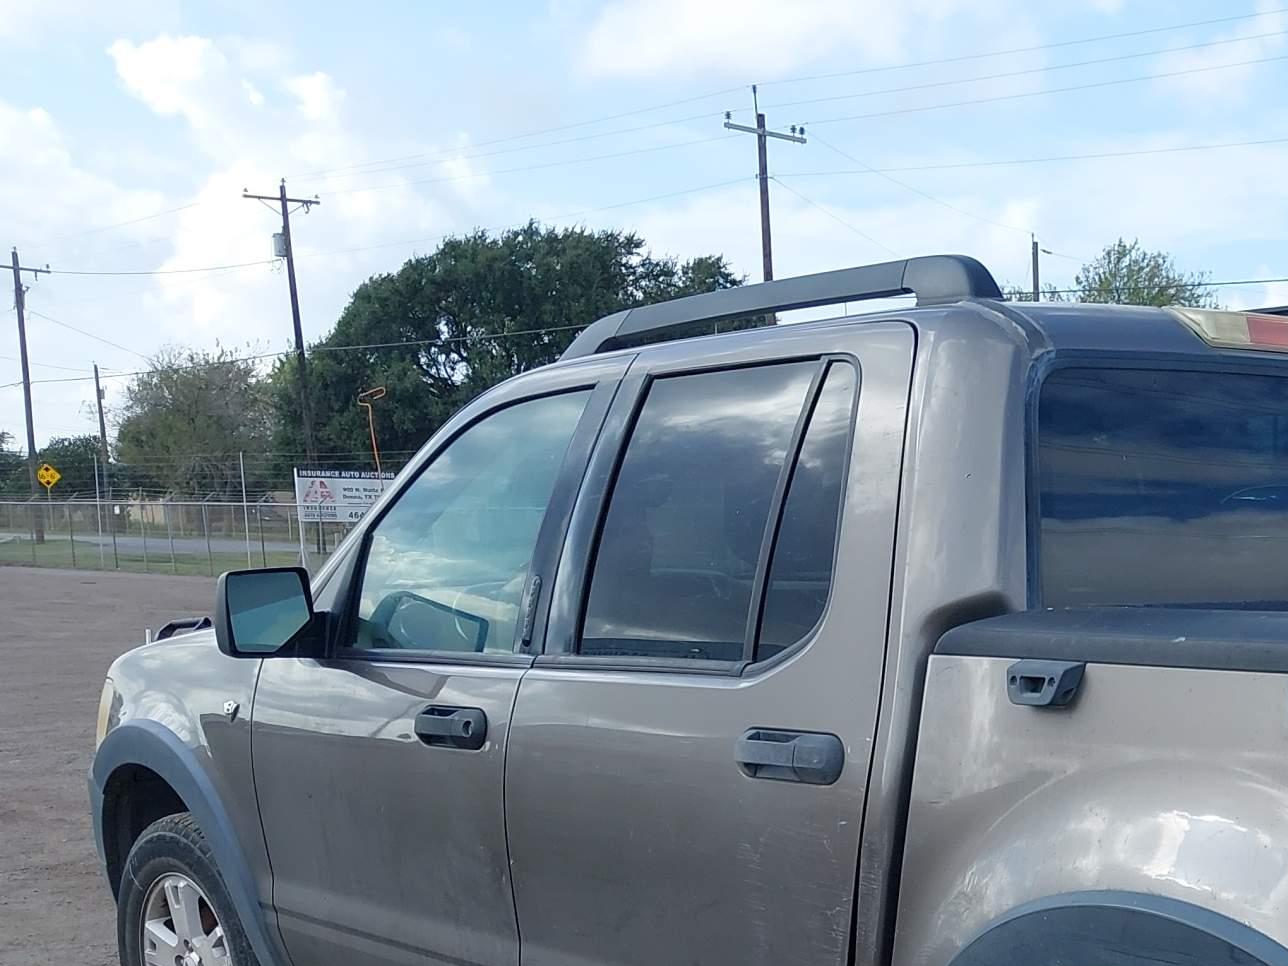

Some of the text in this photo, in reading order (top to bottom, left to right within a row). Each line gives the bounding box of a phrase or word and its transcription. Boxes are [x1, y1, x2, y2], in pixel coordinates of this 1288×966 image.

[299, 470, 395, 480] INSURANCE AUTO AUCTONS
